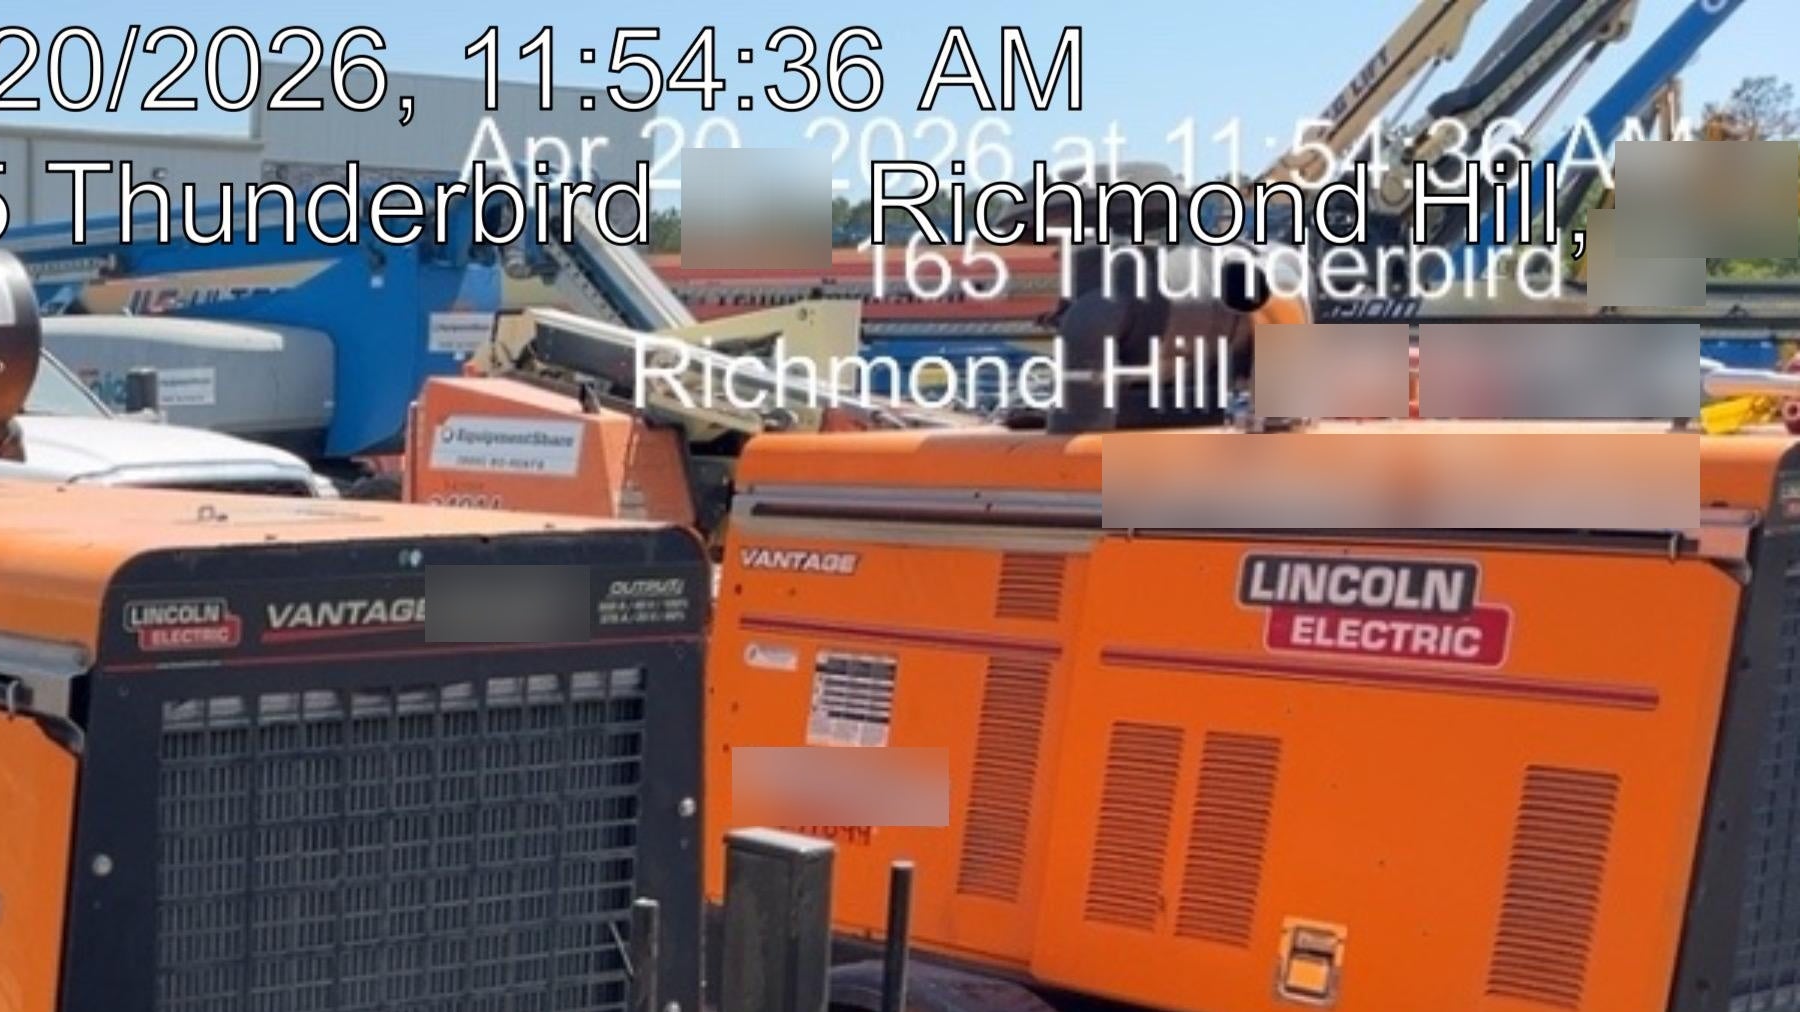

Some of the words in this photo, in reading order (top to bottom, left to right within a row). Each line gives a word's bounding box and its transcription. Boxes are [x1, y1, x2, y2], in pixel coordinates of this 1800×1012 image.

[741, 548, 857, 573] VANTAGE
[1250, 560, 1465, 612] LINCOLN
[130, 604, 220, 624] LINCOLN
[151, 627, 230, 645] ELECTRIC
[1290, 615, 1484, 658] ELECTRIC
